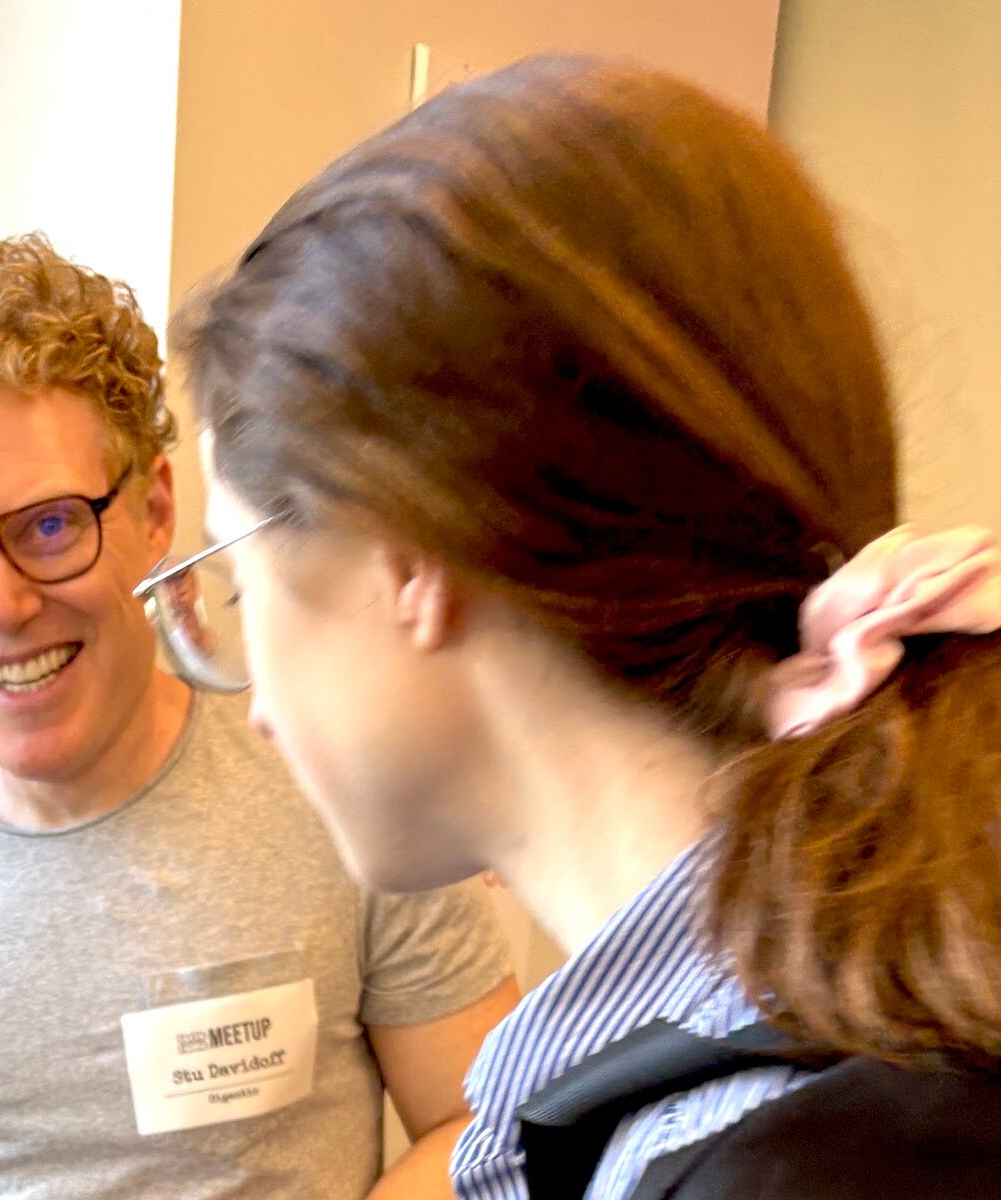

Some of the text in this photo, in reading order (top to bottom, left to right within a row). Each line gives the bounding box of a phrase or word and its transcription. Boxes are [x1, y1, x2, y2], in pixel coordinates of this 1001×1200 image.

[208, 1017, 271, 1048] MEETUP
[172, 1049, 286, 1085] Stu Davidoff
